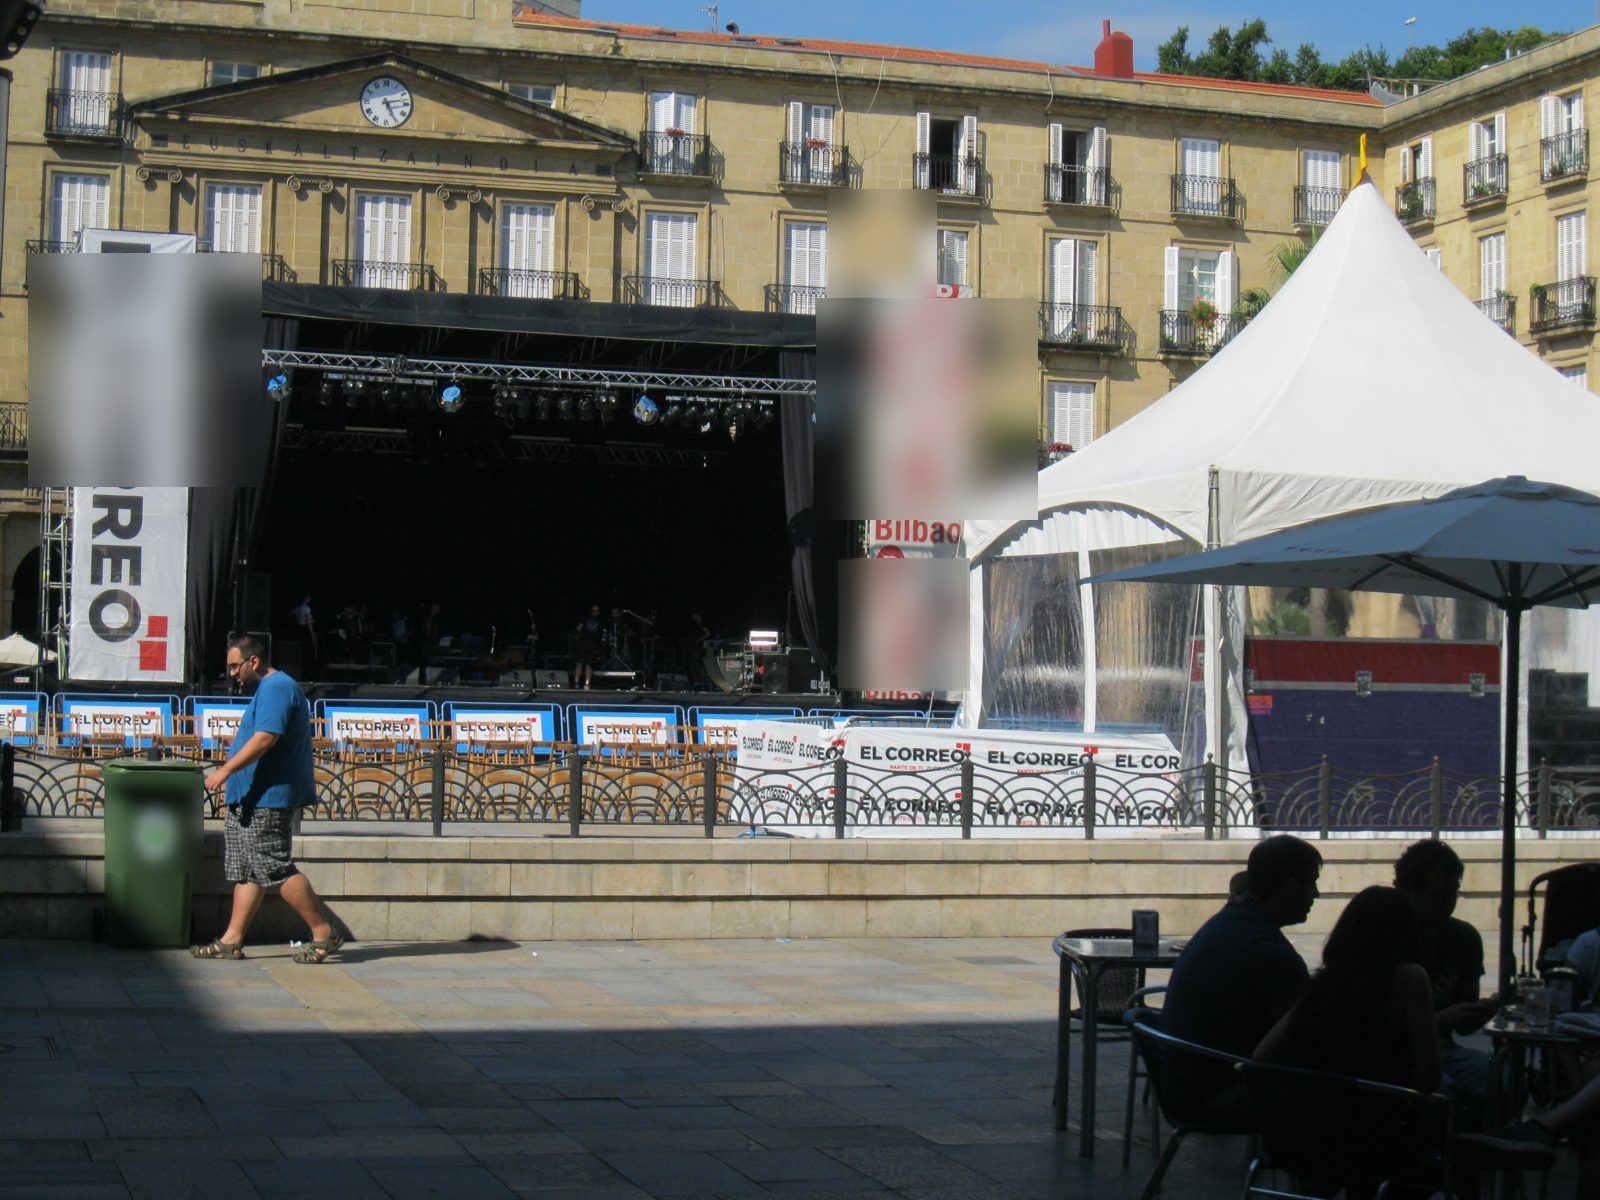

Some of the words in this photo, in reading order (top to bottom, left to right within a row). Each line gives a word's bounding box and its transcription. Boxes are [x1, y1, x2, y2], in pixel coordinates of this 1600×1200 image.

[875, 518, 962, 544] Bilbao
[88, 487, 144, 643] REO
[860, 745, 882, 760] EL
[885, 747, 965, 763] CORREO
[987, 750, 1011, 765] EL
[1013, 752, 1092, 767] CORREO
[1115, 754, 1138, 768] EL
[1141, 755, 1180, 769] COR
